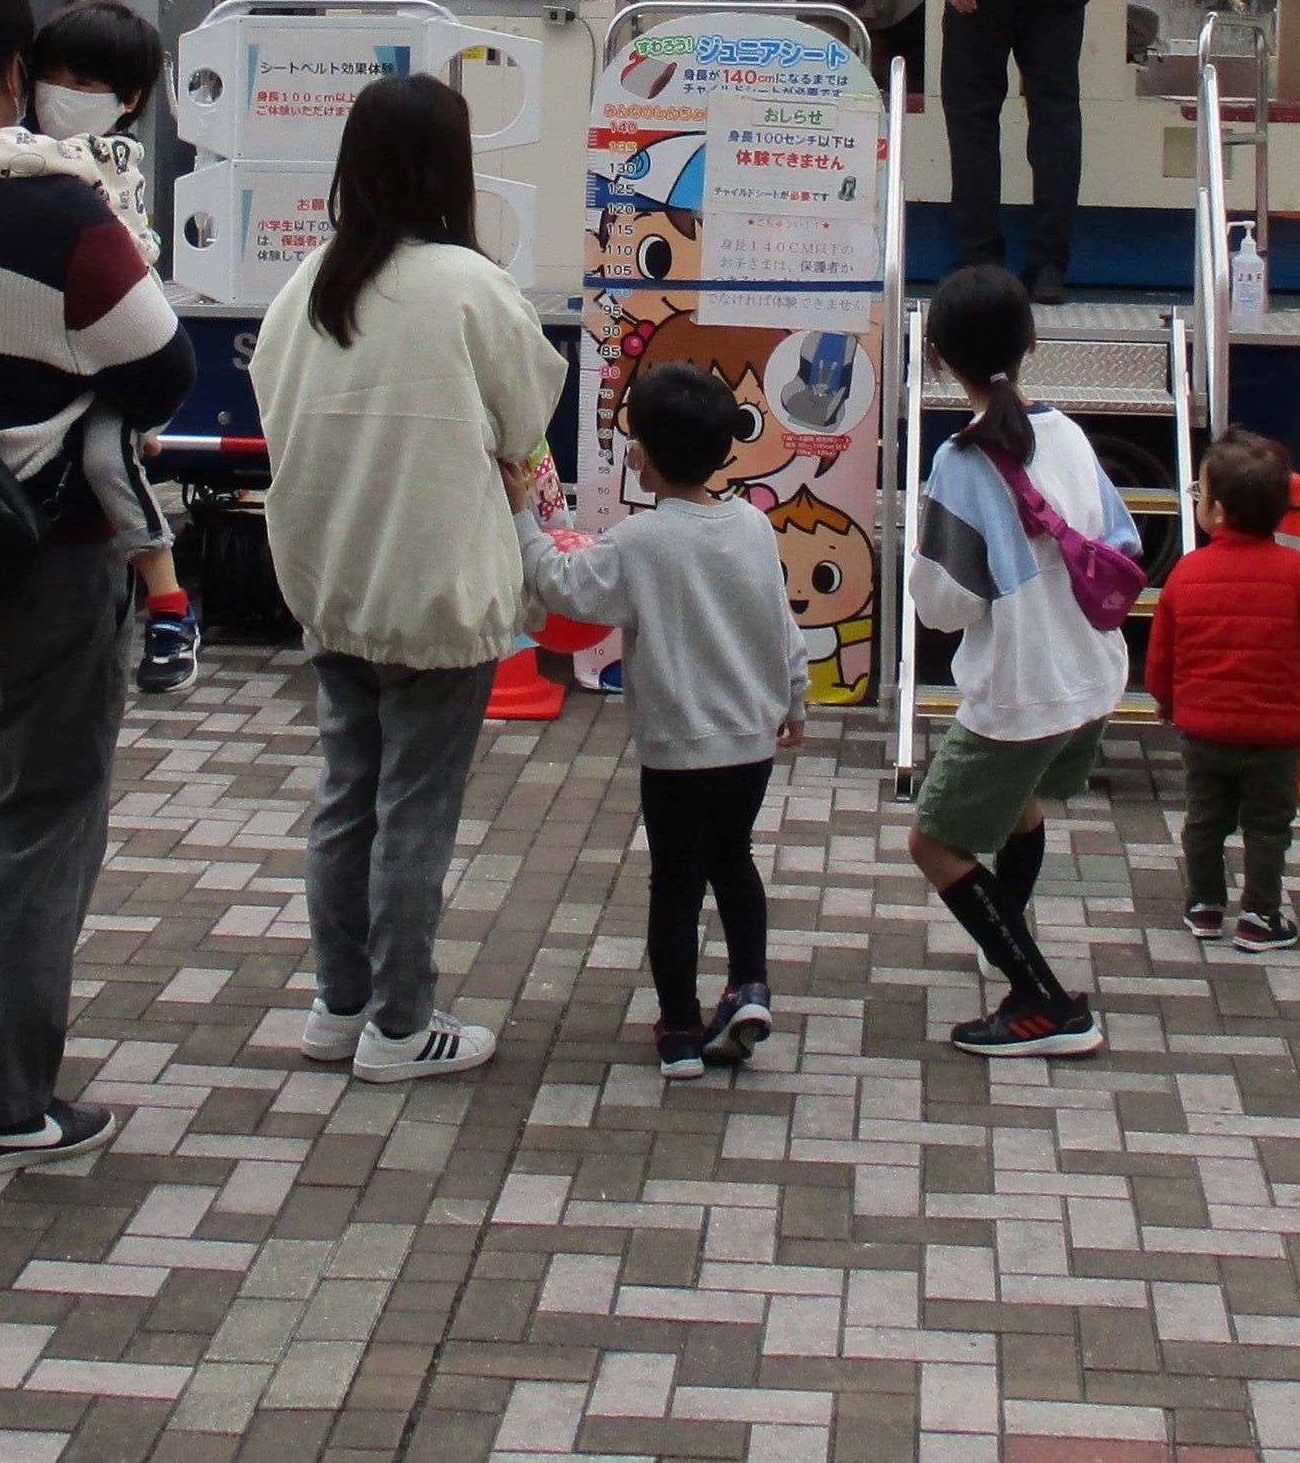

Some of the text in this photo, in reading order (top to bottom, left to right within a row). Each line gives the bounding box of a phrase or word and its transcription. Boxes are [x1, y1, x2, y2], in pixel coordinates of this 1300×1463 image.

[697, 35, 849, 69] ジュニアシート
[260, 61, 395, 75] シートベルト効果体験
[683, 69, 849, 86] 身長が140cmになるまでは
[764, 108, 823, 125] おしらせ
[609, 121, 638, 134] 140
[727, 130, 856, 149] 身長100センチ以下は
[736, 149, 845, 171] 体験できません
[609, 163, 636, 174] 130
[608, 183, 635, 195] 125
[714, 186, 830, 202] チャイルドシートが必要です
[608, 203, 635, 215] 120
[607, 224, 633, 235] 115
[606, 245, 633, 256] 110
[606, 265, 632, 276] 105
[1238, 273, 1262, 282] JAF
[603, 305, 622, 317] 95
[602, 326, 621, 337] 90
[601, 346, 621, 358] 85
[601, 367, 621, 379] 80
[600, 389, 614, 399] 75
[600, 409, 614, 419] 70
[598, 487, 610, 495] 50
[594, 648, 604, 656] 10
